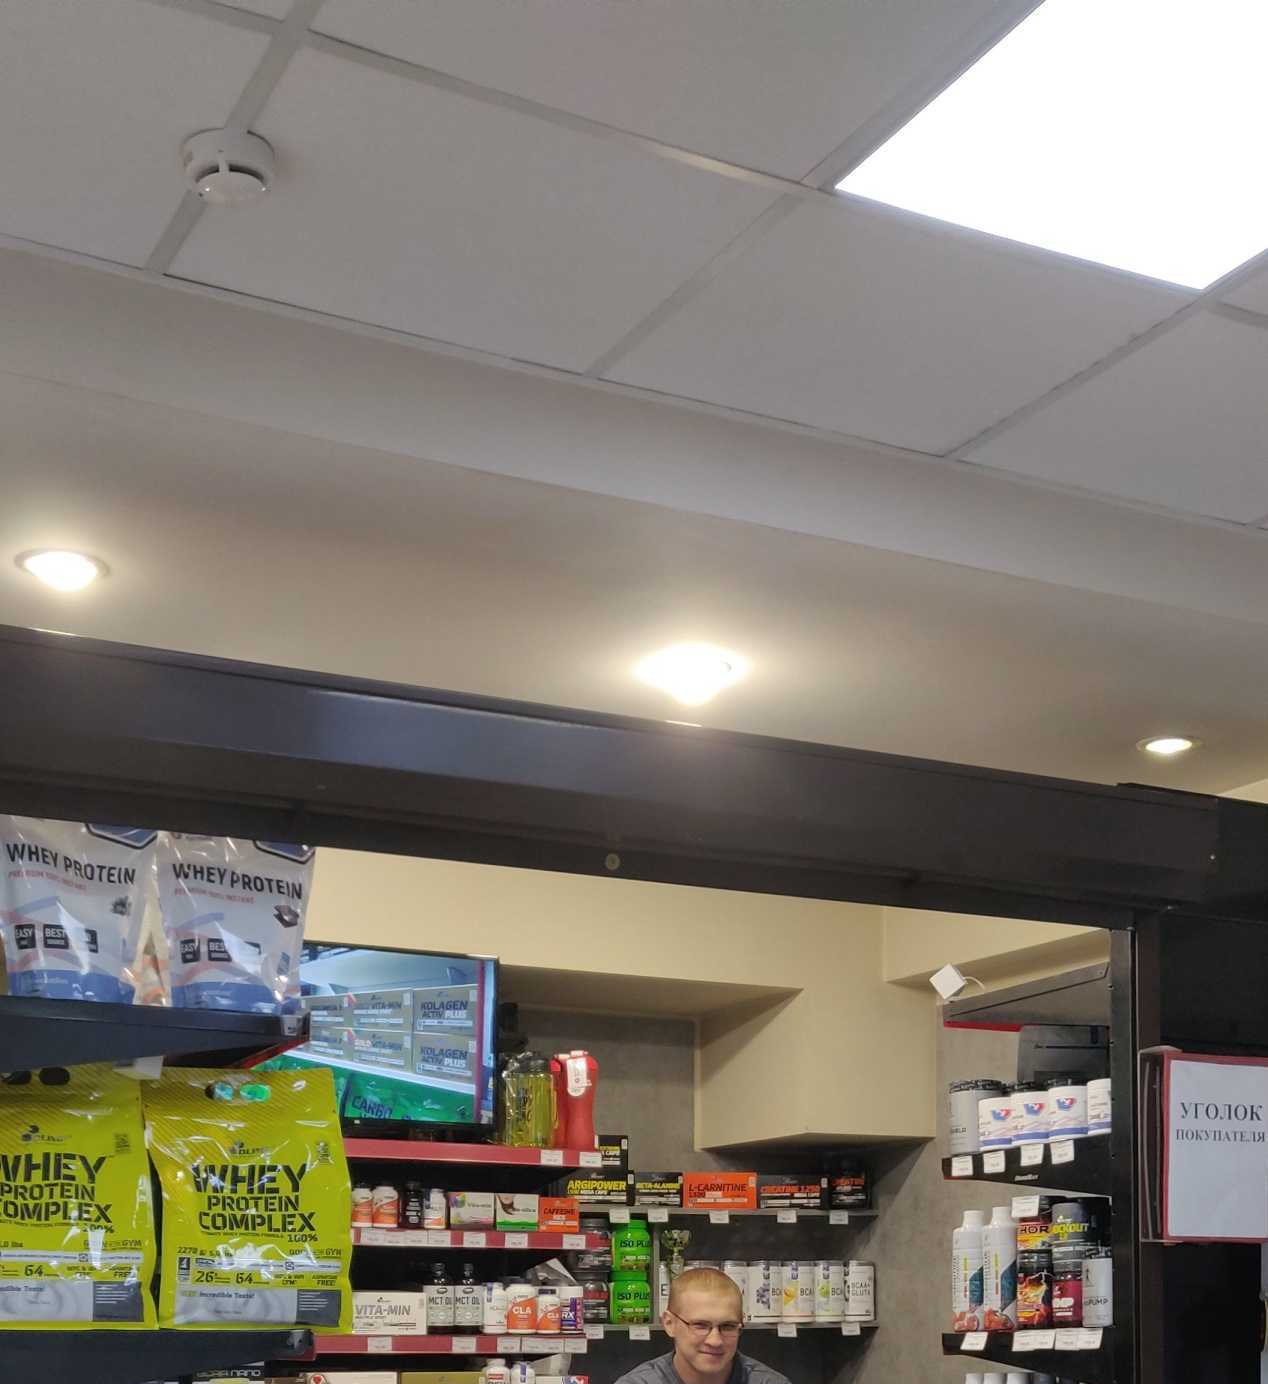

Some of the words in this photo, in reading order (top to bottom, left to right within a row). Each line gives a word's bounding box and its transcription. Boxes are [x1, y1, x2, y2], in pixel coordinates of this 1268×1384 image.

[6, 842, 59, 872] WHEY
[63, 856, 137, 886] PROTEIN
[172, 862, 227, 889] WHEY
[230, 871, 303, 900] PROTEIN
[208, 941, 226, 952] BES
[420, 1000, 468, 1011] KOLAGEN
[420, 1045, 468, 1060] KOLAGEN
[1179, 1101, 1264, 1122] УГОЛОК
[1175, 1128, 1266, 1143] ПОКУПАТЕЛЯ
[192, 1163, 308, 1195] WHEY
[567, 1180, 627, 1191] ARGIPOWER
[688, 1183, 748, 1192] L-CARNITINE
[0, 1182, 96, 1202] PROTEIN
[206, 1194, 300, 1213] PROTEIN
[0, 1200, 114, 1224] OMPLEX
[198, 1210, 317, 1234] COMPLEX
[1020, 1225, 1049, 1234] HOR
[287, 1233, 318, 1243] 100%
[635, 1240, 651, 1248] PLU
[24, 1264, 44, 1278] 64
[235, 1272, 254, 1285] 64
[428, 1296, 444, 1305] MCT
[455, 1296, 470, 1305] MCT
[633, 1292, 651, 1301] PLU
[355, 1305, 411, 1316] VITA-MIN
[511, 1306, 532, 1315] CLA
